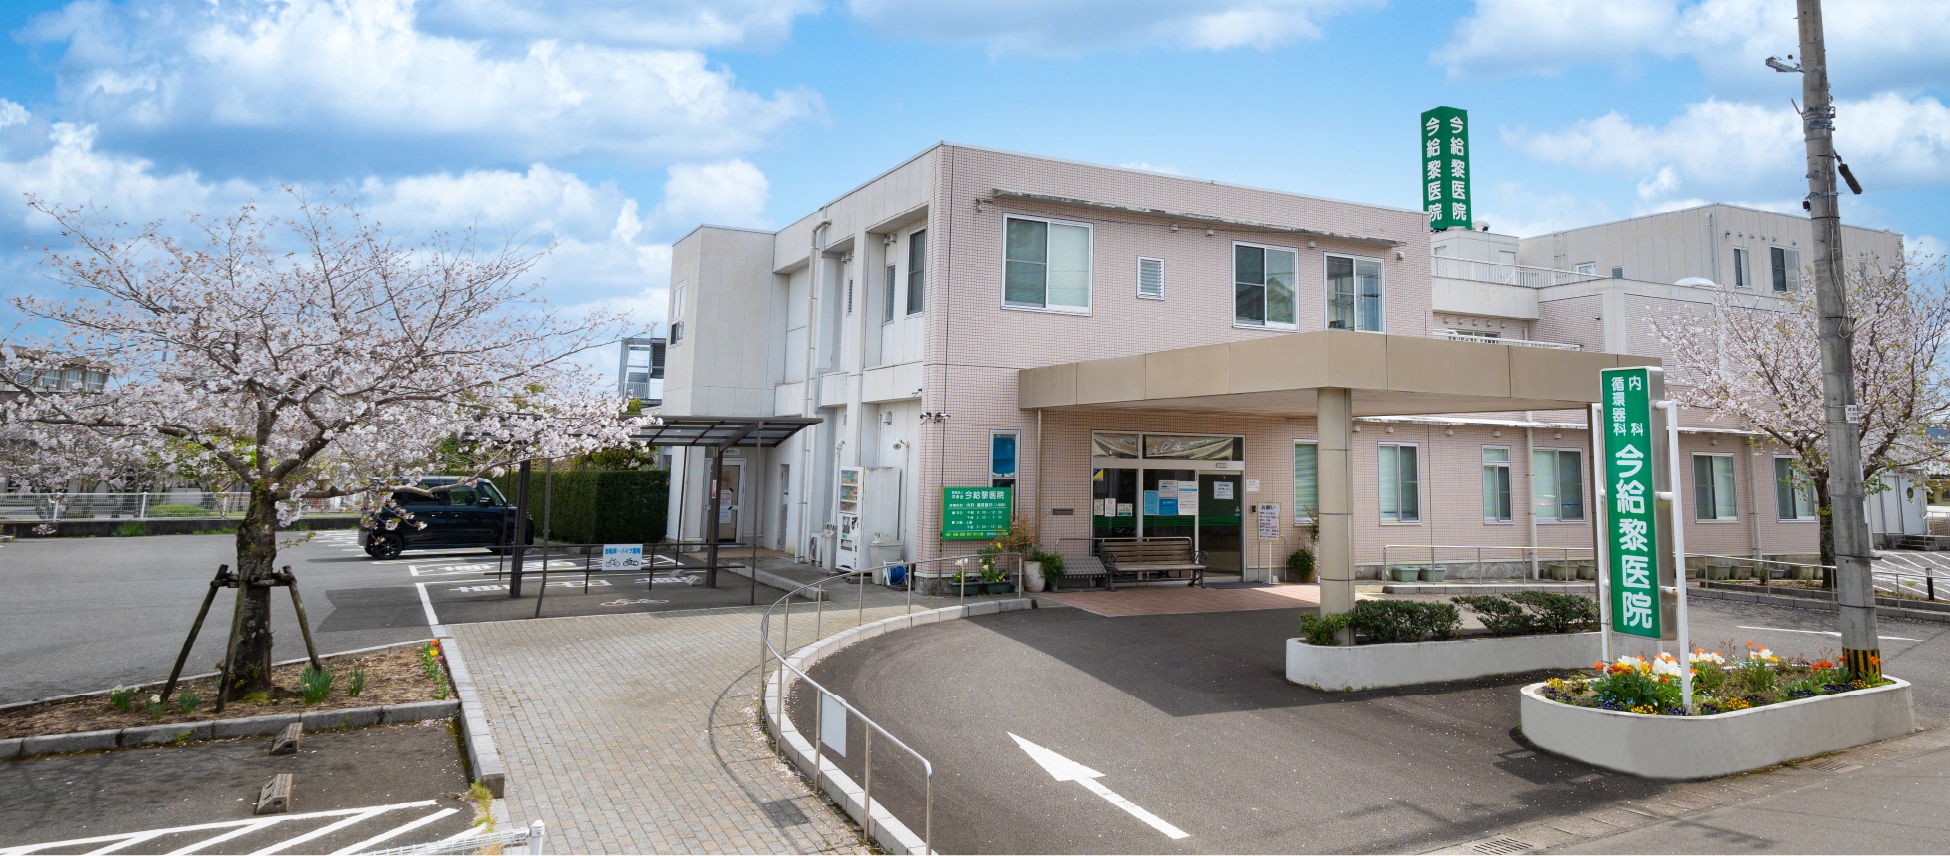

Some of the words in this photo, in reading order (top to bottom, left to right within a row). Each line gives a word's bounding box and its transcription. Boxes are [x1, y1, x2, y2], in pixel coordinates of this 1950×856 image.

[1426, 117, 1442, 222] 今給黎医院
[1449, 115, 1466, 221] 今給黎医院
[1611, 376, 1626, 436] 循環器科
[1628, 375, 1643, 436] 内科
[965, 491, 1004, 500] 今給黎医院
[1615, 443, 1652, 628] 今給黎医院
